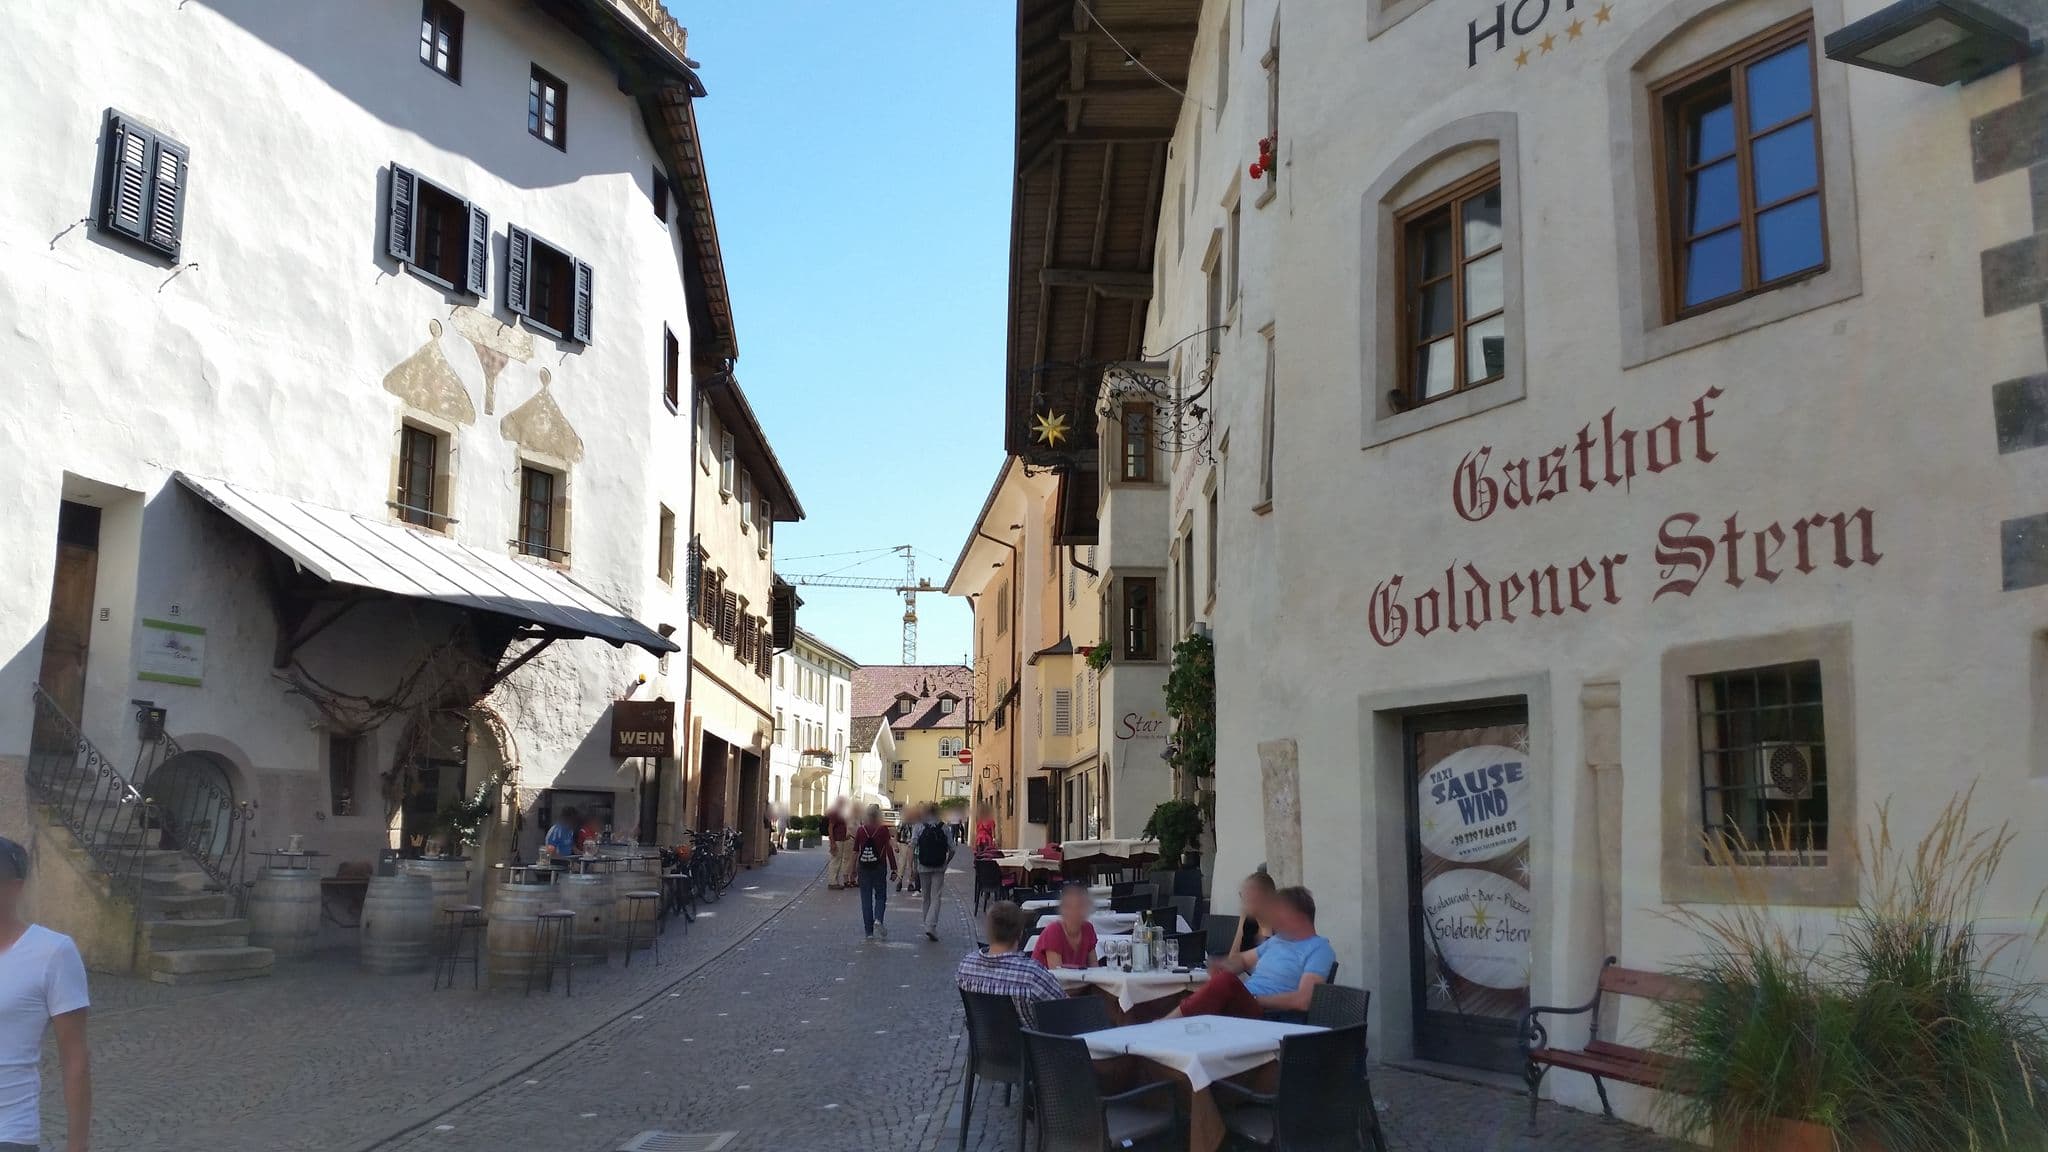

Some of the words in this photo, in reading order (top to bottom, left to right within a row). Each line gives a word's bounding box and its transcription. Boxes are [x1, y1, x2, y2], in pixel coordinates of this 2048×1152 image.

[1468, 0, 1576, 69] HO
[1452, 385, 1725, 522] Gasthof
[1368, 553, 1628, 647] Goldener
[1651, 505, 1884, 603] Stern
[619, 731, 665, 745] WEIN
[1115, 712, 1163, 740] Star
[1431, 763, 1524, 805] SAUSE
[1457, 787, 1509, 826] WIND
[1434, 915, 1492, 941] Goldener
